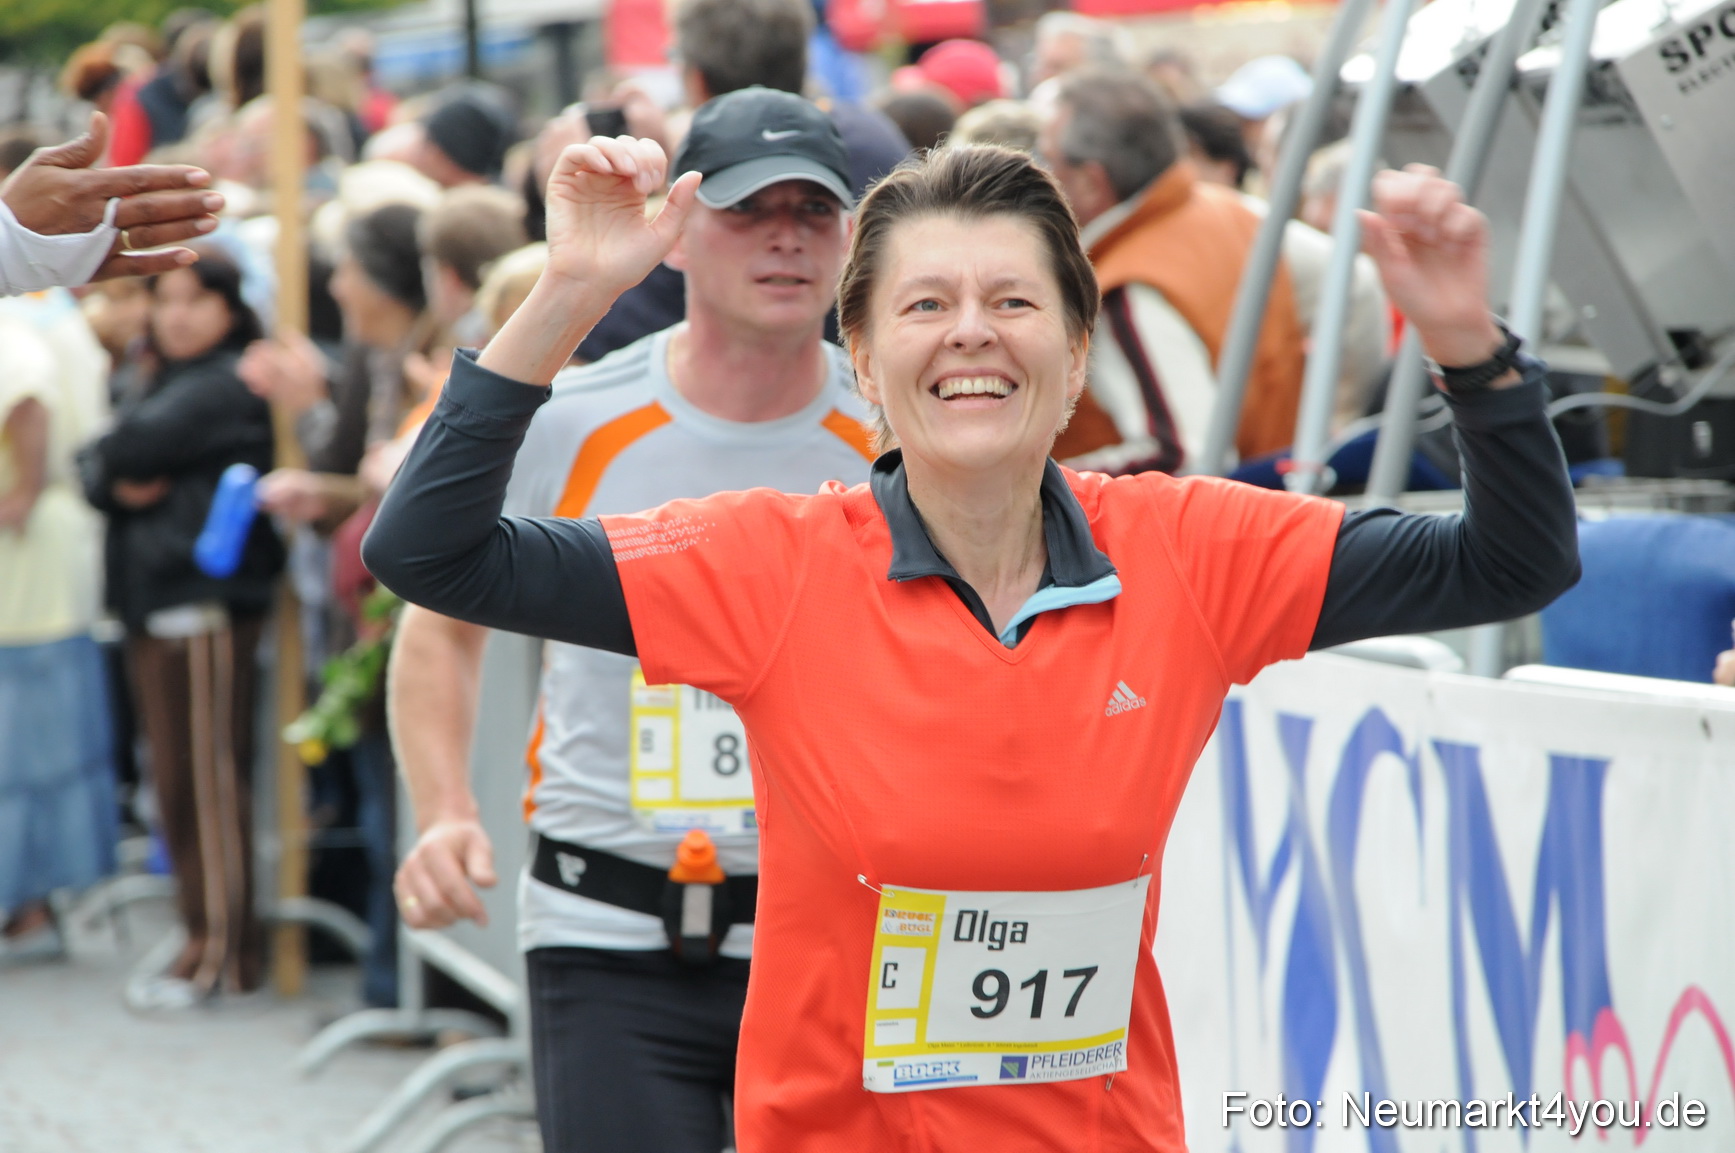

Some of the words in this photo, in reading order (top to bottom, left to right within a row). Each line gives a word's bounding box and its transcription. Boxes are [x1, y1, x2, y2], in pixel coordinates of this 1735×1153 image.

[1104, 696, 1147, 717] adidas
[714, 733, 748, 776] 8
[953, 909, 1029, 951] Olga
[881, 962, 898, 989] C
[970, 965, 1099, 1019] 917
[1030, 1058, 1123, 1079] AKTIENGESELLSCHAFT
[1031, 1041, 1123, 1069] PFLEIDERER
[894, 1061, 960, 1079] BOCK
